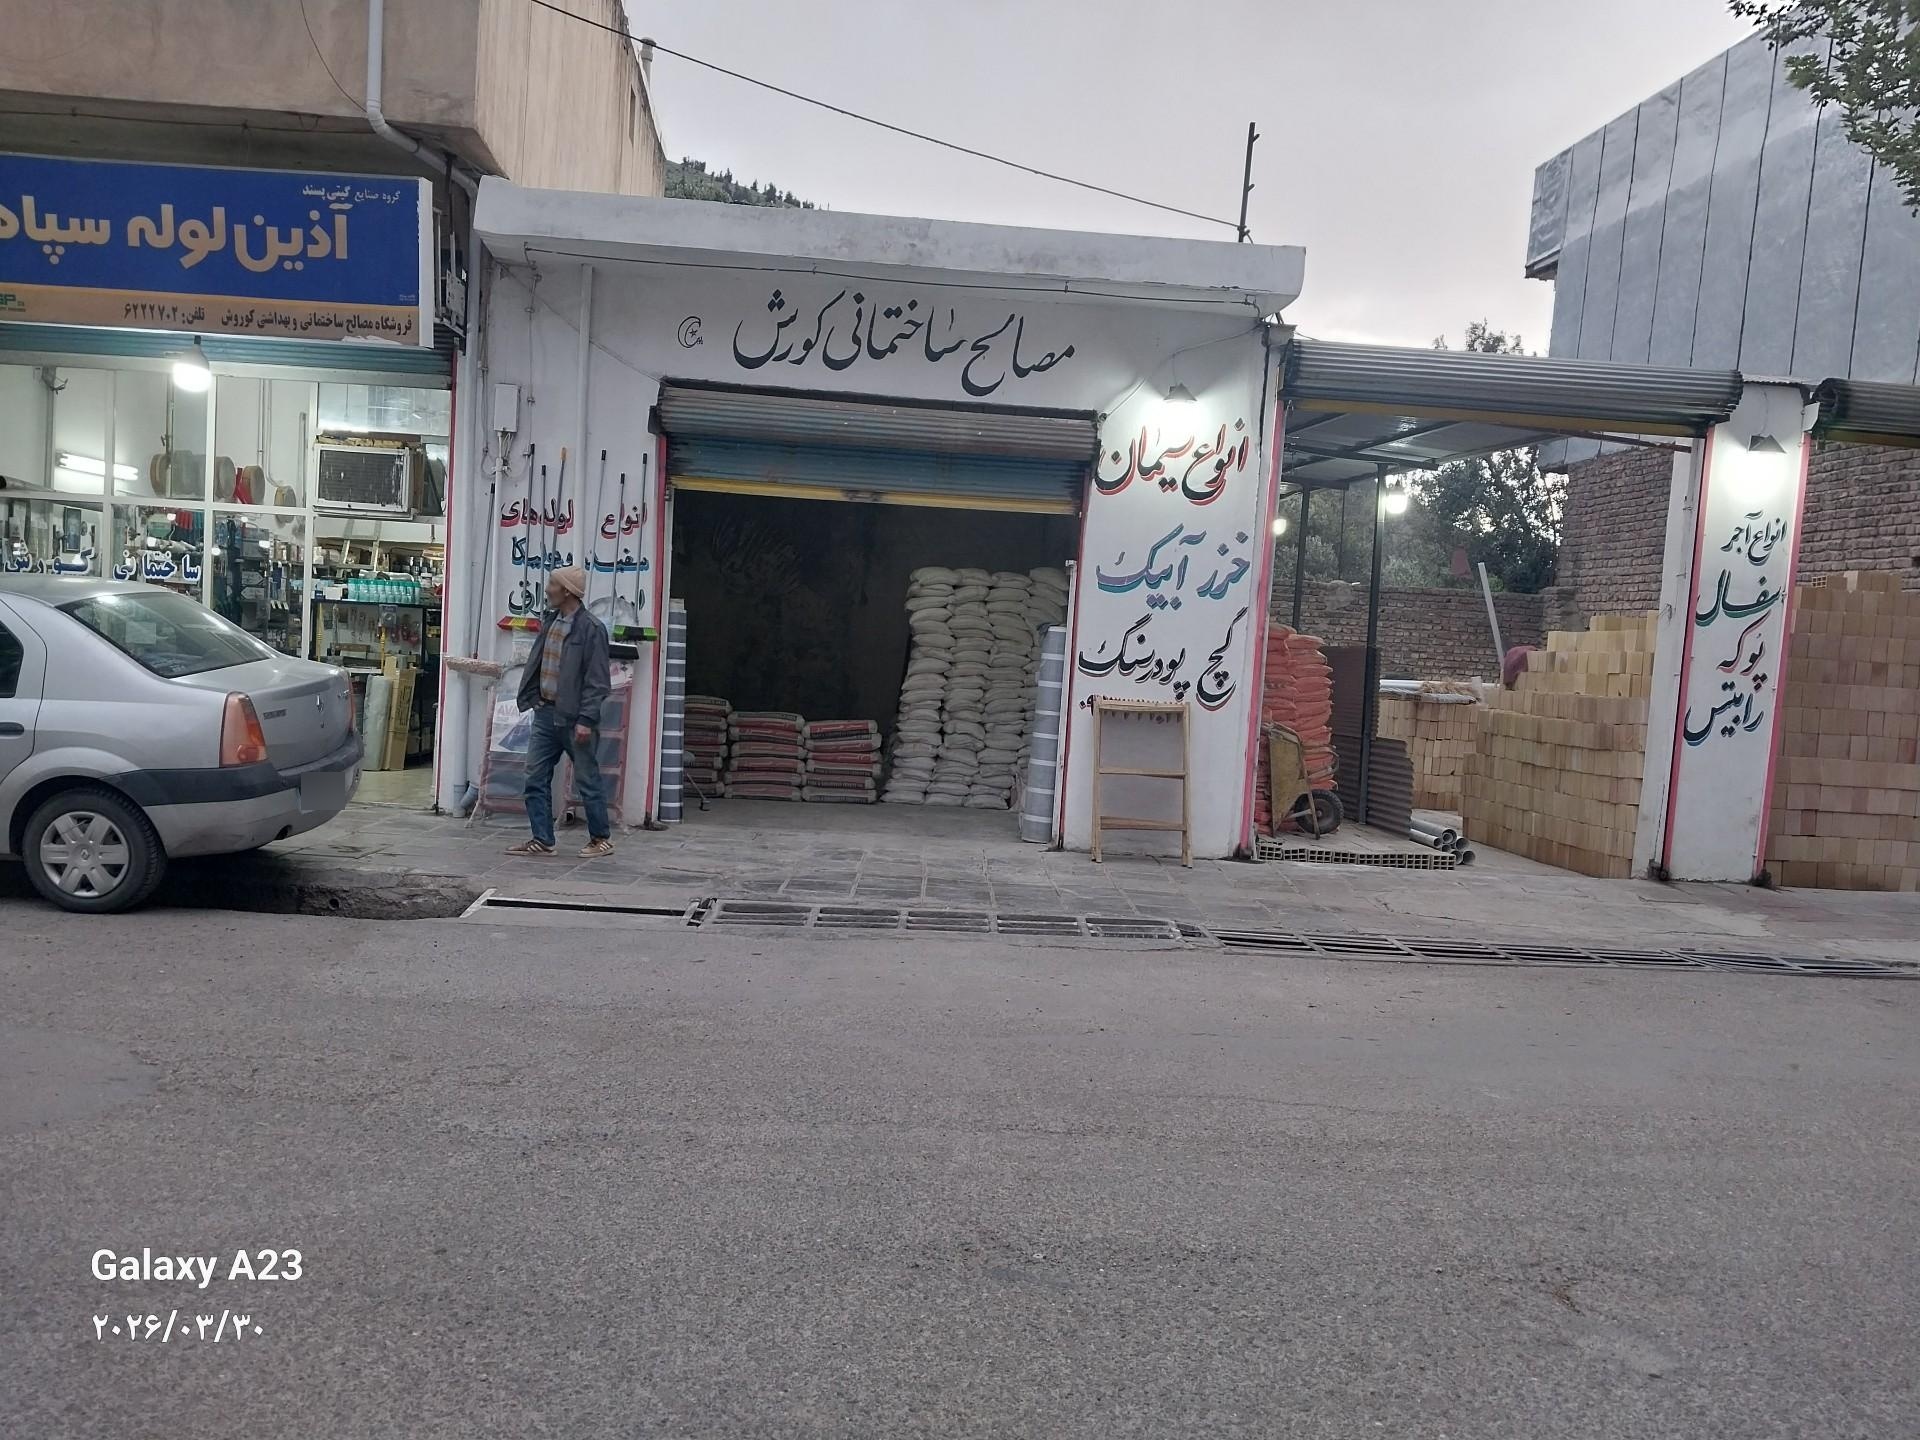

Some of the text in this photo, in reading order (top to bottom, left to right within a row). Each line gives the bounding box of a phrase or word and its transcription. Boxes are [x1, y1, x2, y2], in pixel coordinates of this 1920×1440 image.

[354, 188, 379, 202] صنایع
[382, 190, 401, 204] گروه
[126, 203, 226, 270] لوله
[233, 202, 354, 273] آذین
[221, 309, 255, 327] کوروش
[299, 311, 344, 331] ساختمانی
[345, 313, 374, 334] مصالح
[375, 313, 412, 336] فروشگاه
[733, 288, 1076, 397] مصالح ساختمانی کورش
[1094, 417, 1250, 506] انواع سیمان
[1196, 530, 1252, 600] خزر
[1720, 509, 1788, 565] انواع آجر
[1694, 567, 1782, 628] سفال
[1195, 606, 1249, 712] گچ
